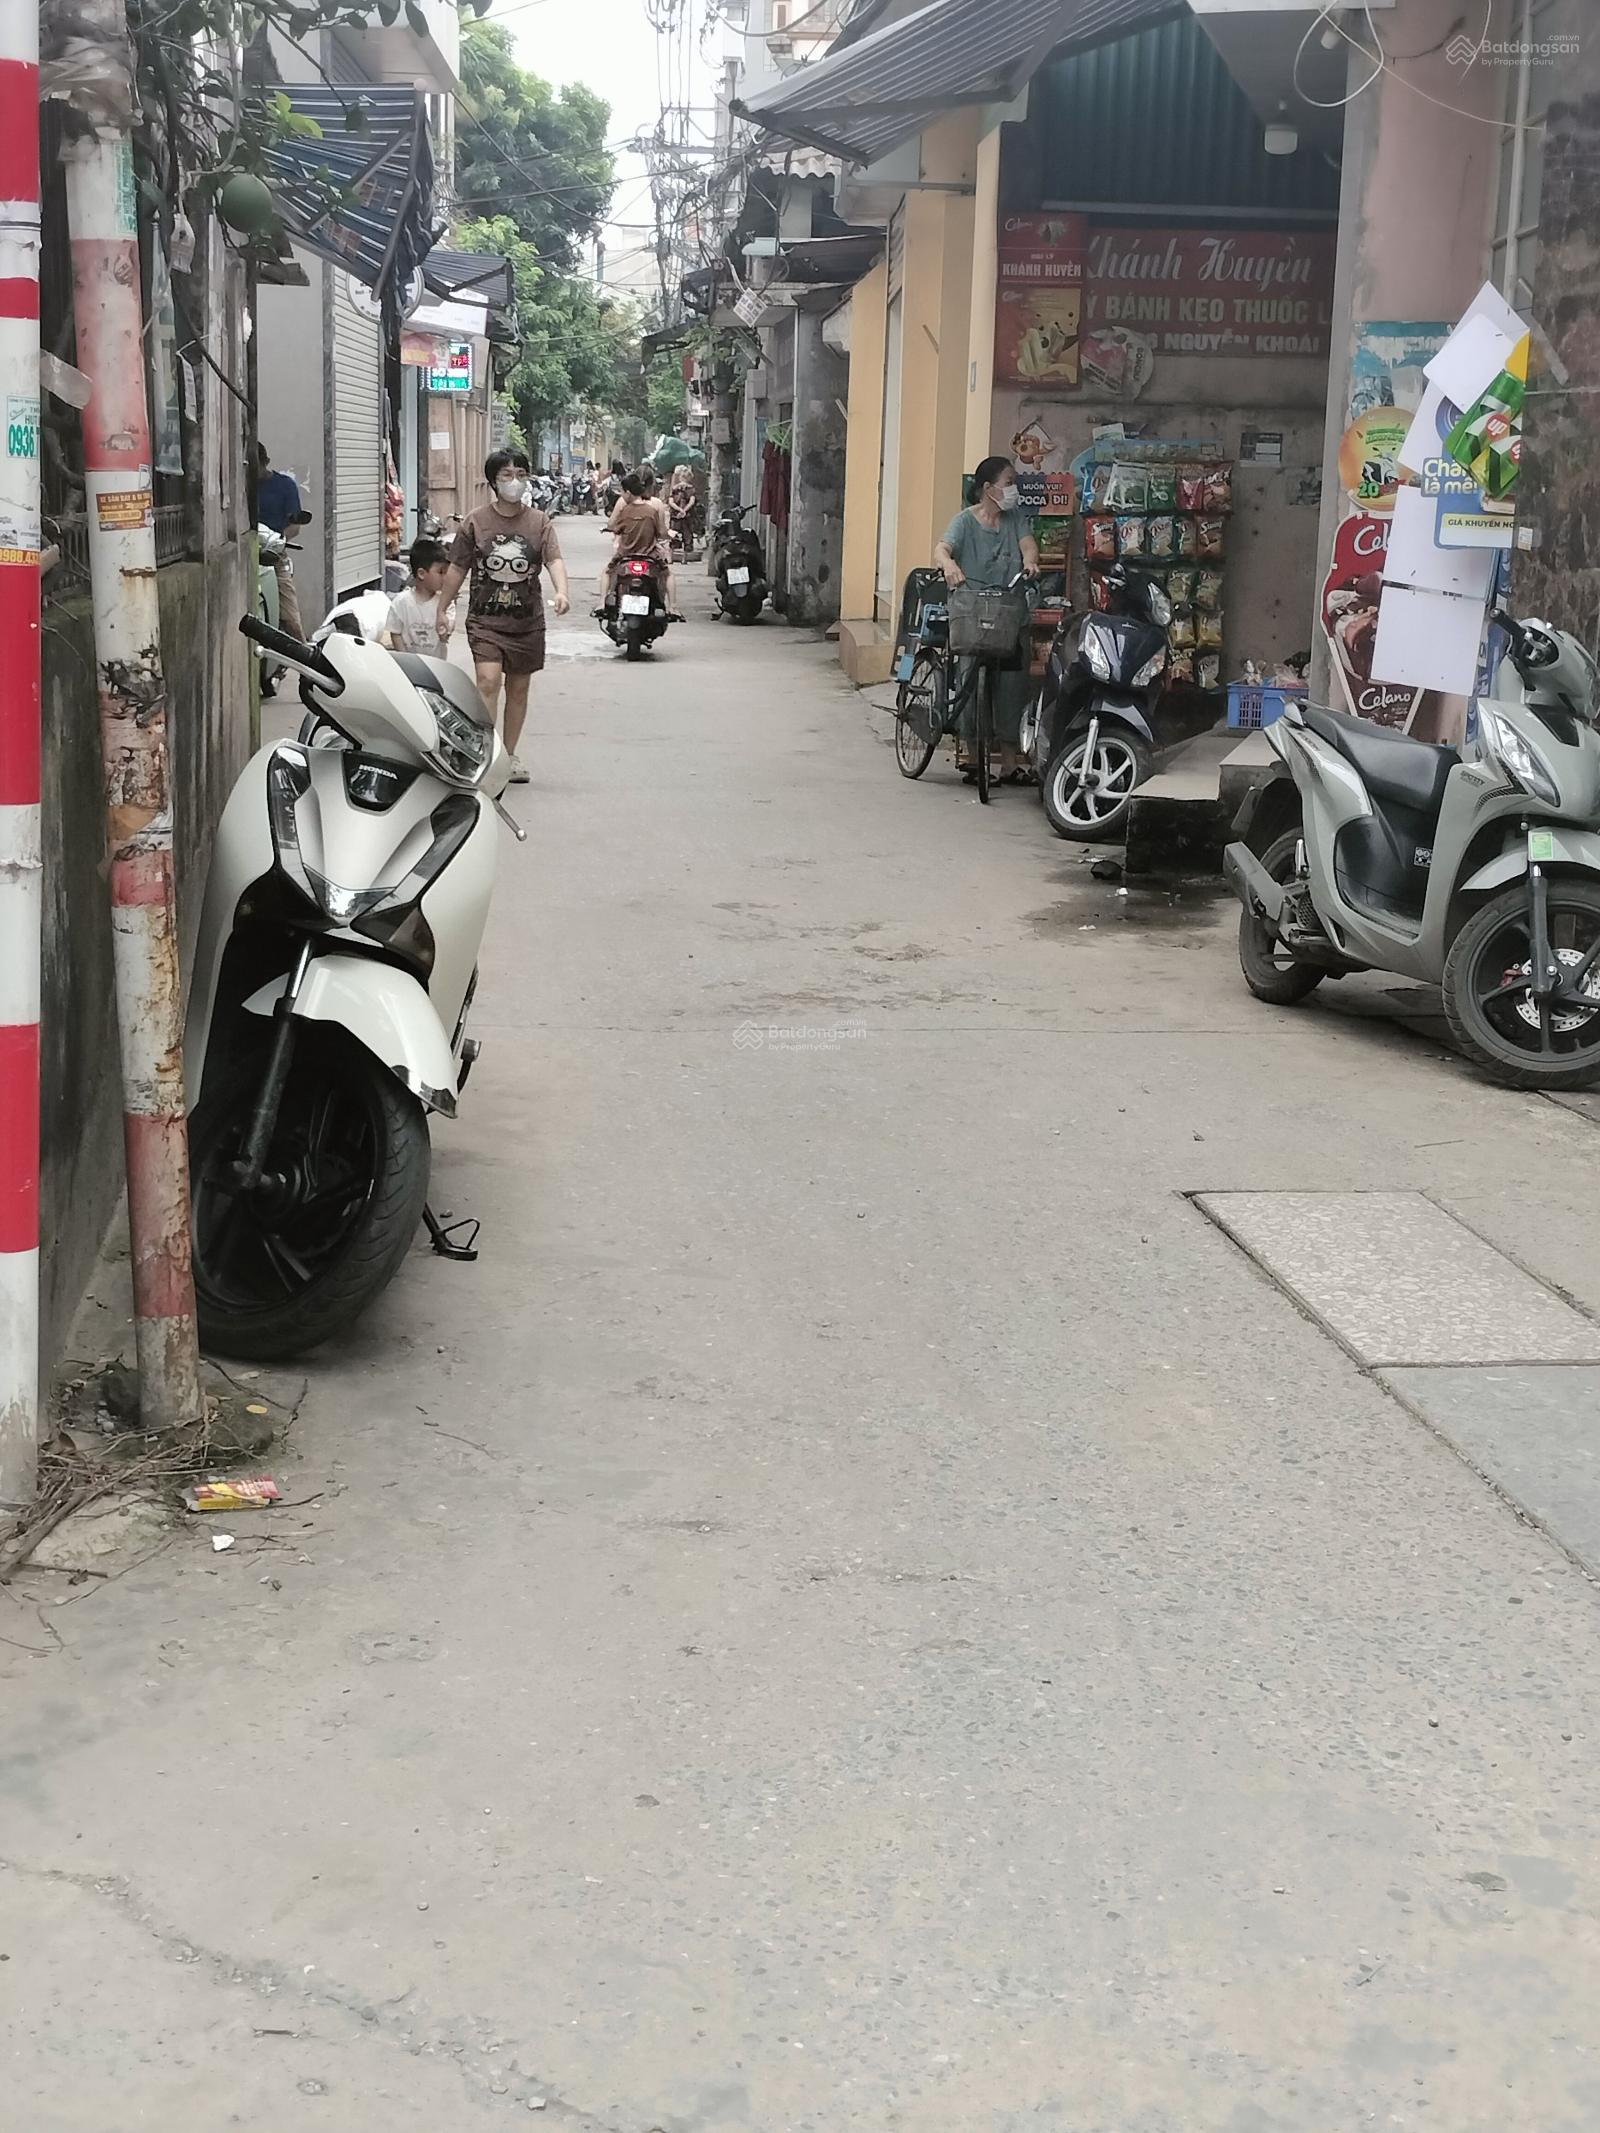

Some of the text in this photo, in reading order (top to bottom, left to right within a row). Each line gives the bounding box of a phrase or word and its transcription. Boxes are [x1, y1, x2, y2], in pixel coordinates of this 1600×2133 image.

[1105, 289, 1171, 320] BÁNH
[1357, 480, 1380, 498] 20
[1424, 477, 1441, 494] là
[1018, 495, 1047, 505] POCA
[1448, 518, 1463, 526] GIÁ
[1354, 522, 1389, 556] Cel
[1359, 686, 1411, 710] Celano
[359, 764, 398, 780] HONDA
